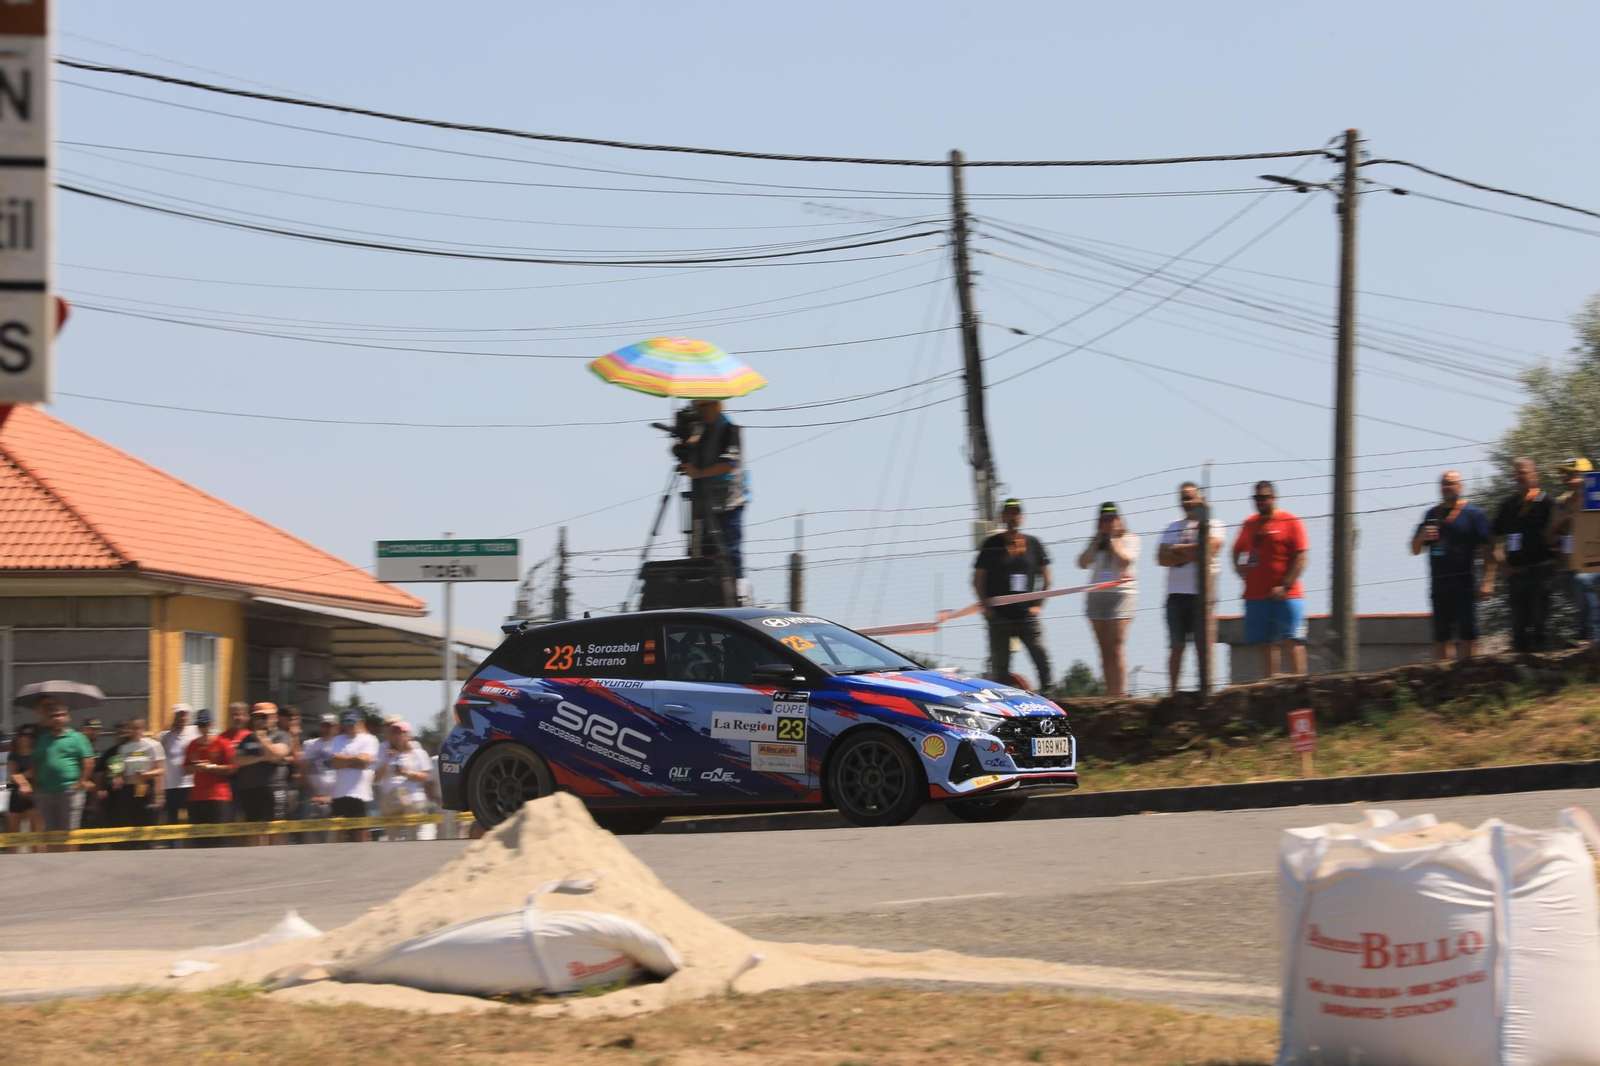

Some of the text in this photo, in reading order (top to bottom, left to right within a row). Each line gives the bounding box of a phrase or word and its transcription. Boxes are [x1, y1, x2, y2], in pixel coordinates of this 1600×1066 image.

[574, 643, 640, 654] A. Sorozabal
[543, 645, 574, 670] 23
[585, 657, 626, 667] Serrano
[596, 680, 644, 689] HYUNDAI
[714, 718, 730, 729] La
[778, 719, 804, 739] 23
[1036, 740, 1054, 754] 9169
[1359, 930, 1485, 969] BELLO
